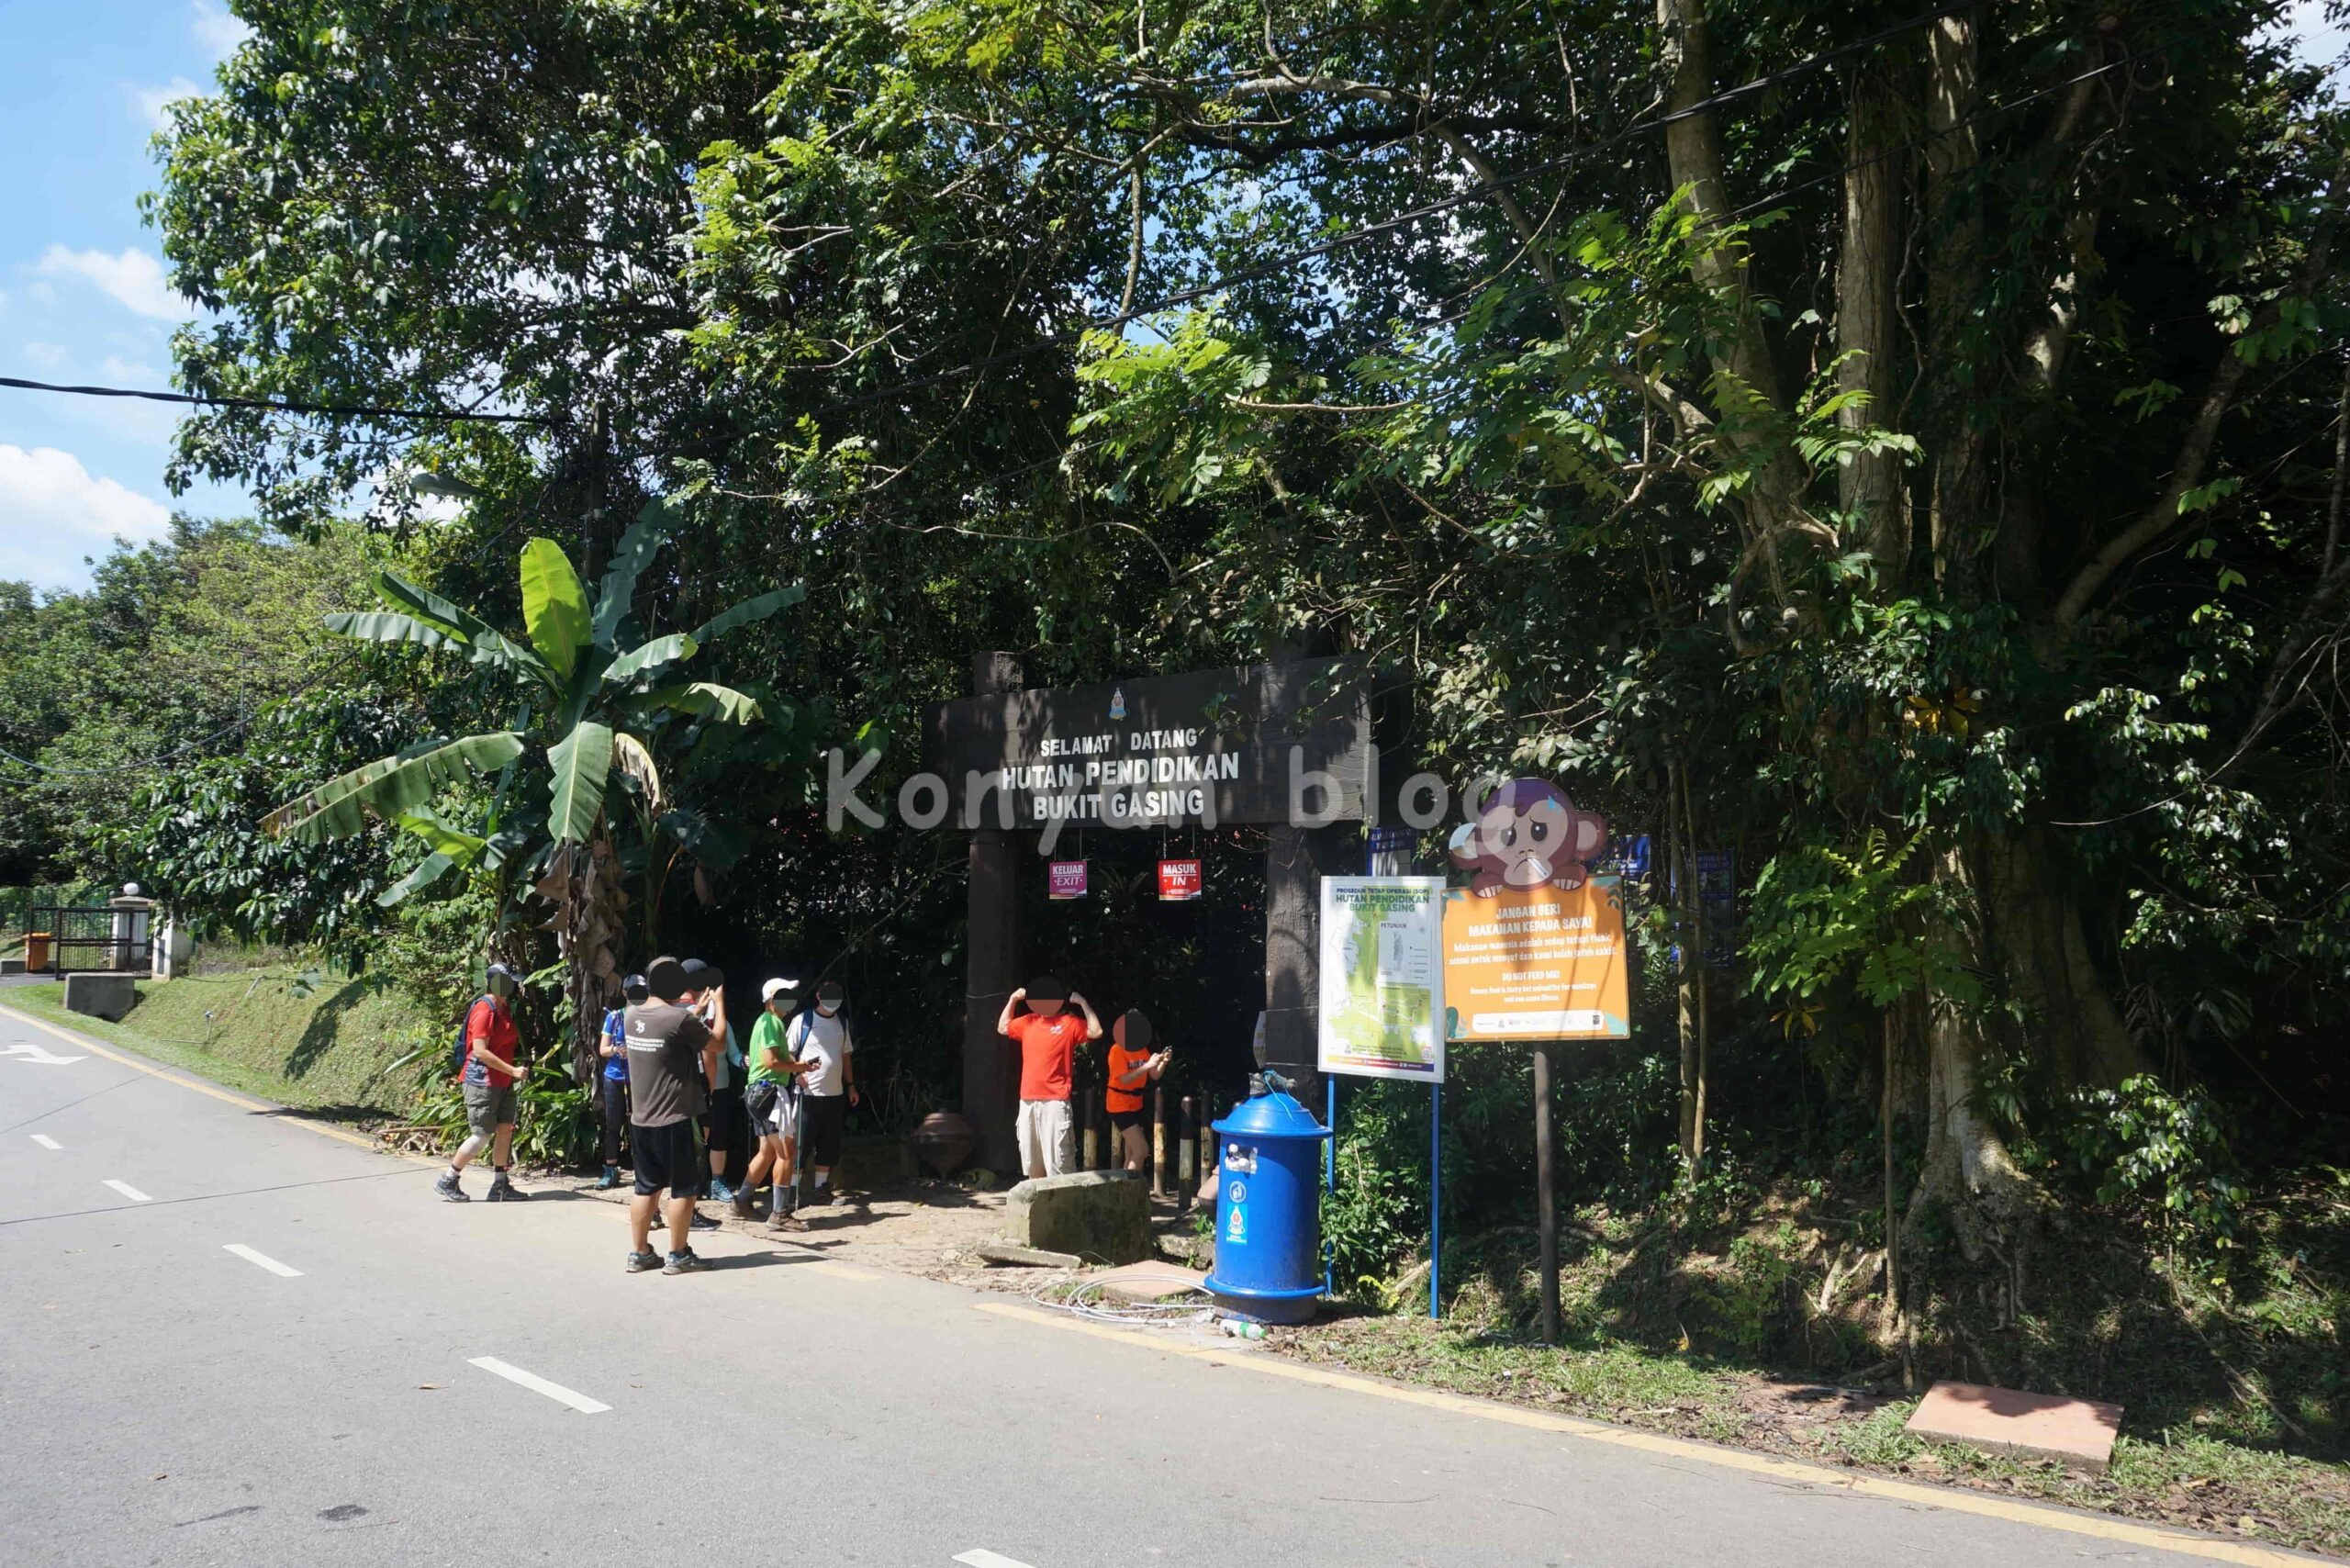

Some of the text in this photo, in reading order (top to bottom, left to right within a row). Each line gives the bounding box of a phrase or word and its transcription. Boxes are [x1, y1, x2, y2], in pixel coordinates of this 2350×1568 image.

[1040, 728, 1197, 757] SELAMAT DATANG
[1002, 752, 1239, 790] HUTAN PENDIDIKAN
[1034, 790, 1203, 820] BUKIT GASING
[1053, 865, 1083, 874] KELUAR
[1163, 864, 1196, 874] MASUK
[1057, 877, 1080, 886] EXIT
[1172, 876, 1186, 886] IN
[1337, 894, 1429, 903] HUTAN PENDIDIKAN
[1349, 903, 1415, 913] BUKIT GASING
[1496, 903, 1561, 919] JANGAN BERI
[1469, 916, 1592, 936] MAKANAN KEPADA SAYA!
[1519, 937, 1543, 947] adalah
[1519, 952, 1532, 960] dan
[1502, 972, 1512, 981] DO
[1513, 971, 1527, 980] NOT
[1528, 970, 1545, 980] FEED
